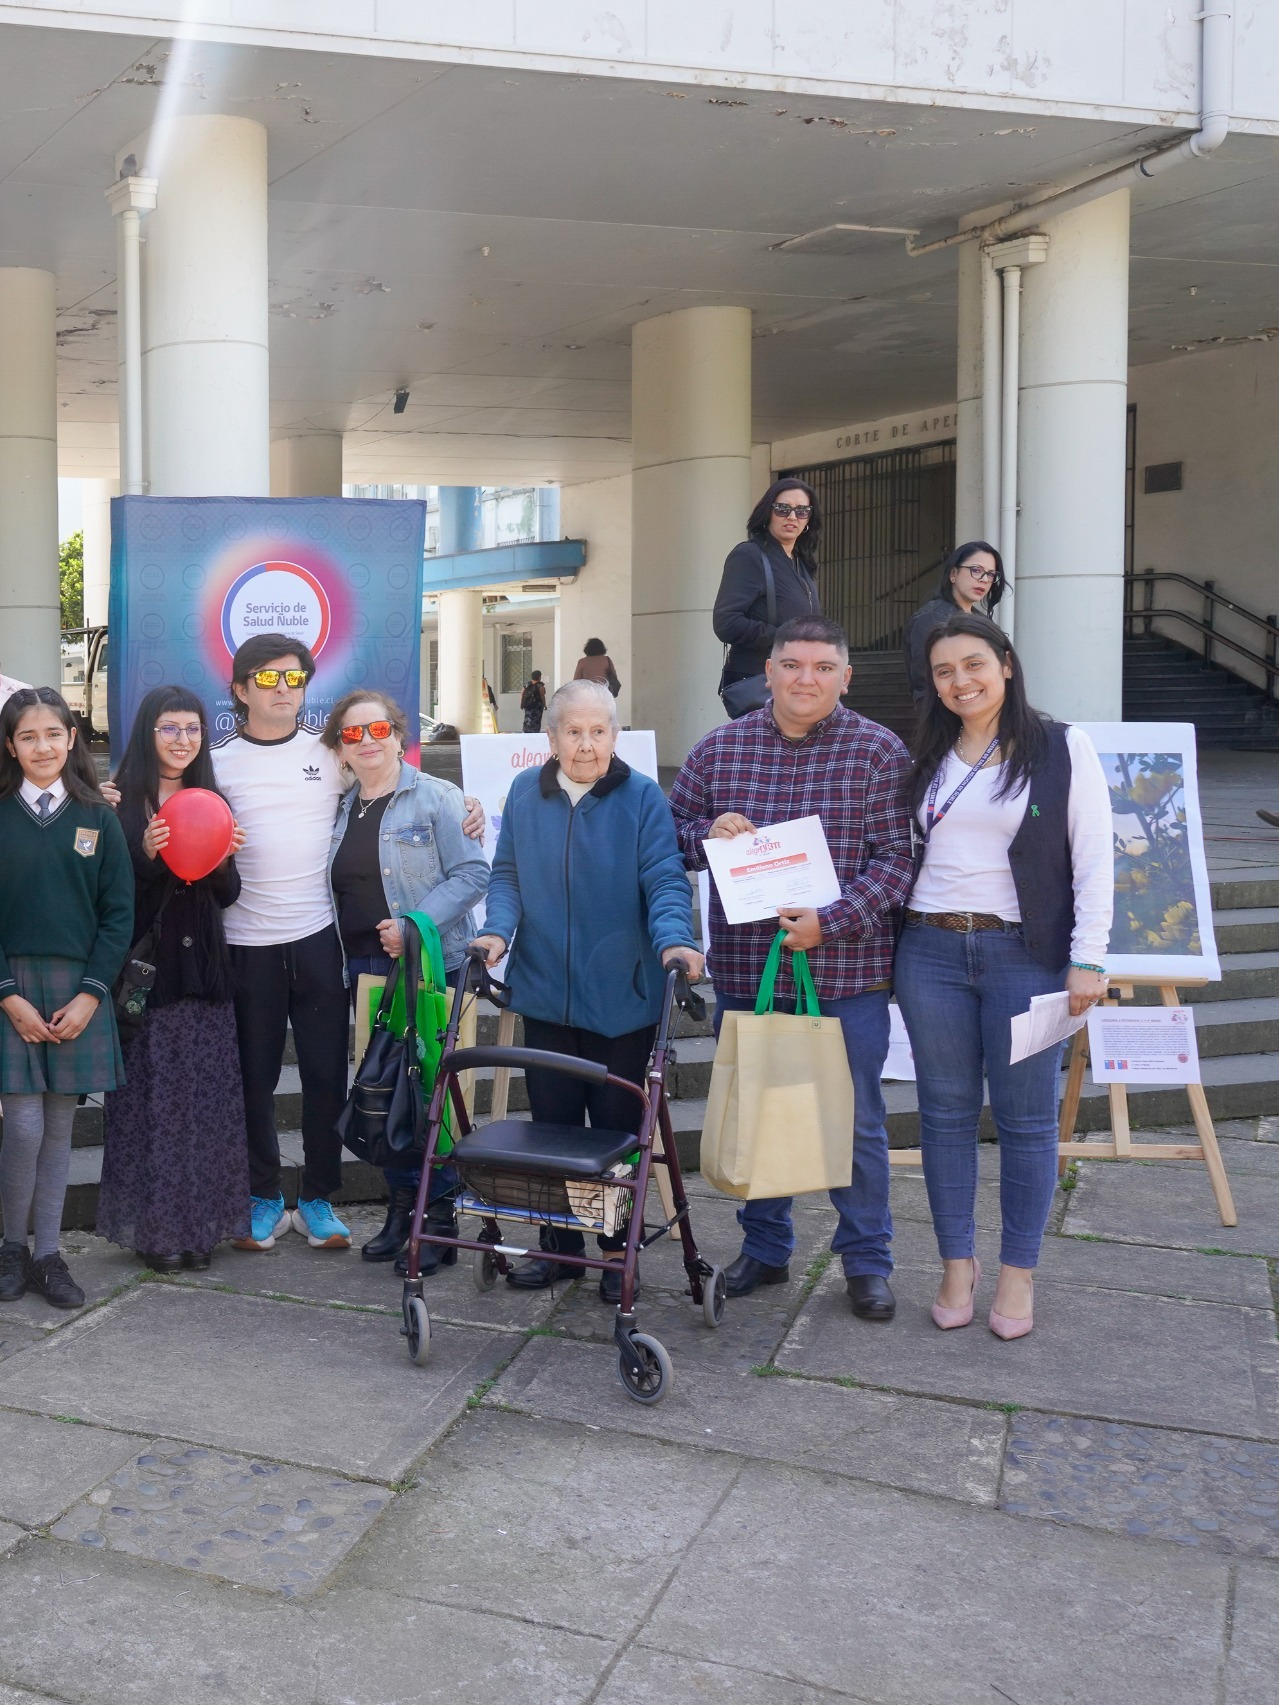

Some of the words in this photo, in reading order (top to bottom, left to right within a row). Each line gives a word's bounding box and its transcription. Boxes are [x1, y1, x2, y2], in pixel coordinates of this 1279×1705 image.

[836, 430, 880, 448] CORTE
[892, 423, 909, 438] DE
[246, 602, 290, 614] Servicio
[293, 602, 307, 613] de
[243, 615, 274, 627] Salud
[277, 613, 309, 626] Ñuble
[746, 863, 773, 873] Emiliano
[774, 859, 791, 867] Ortiz
